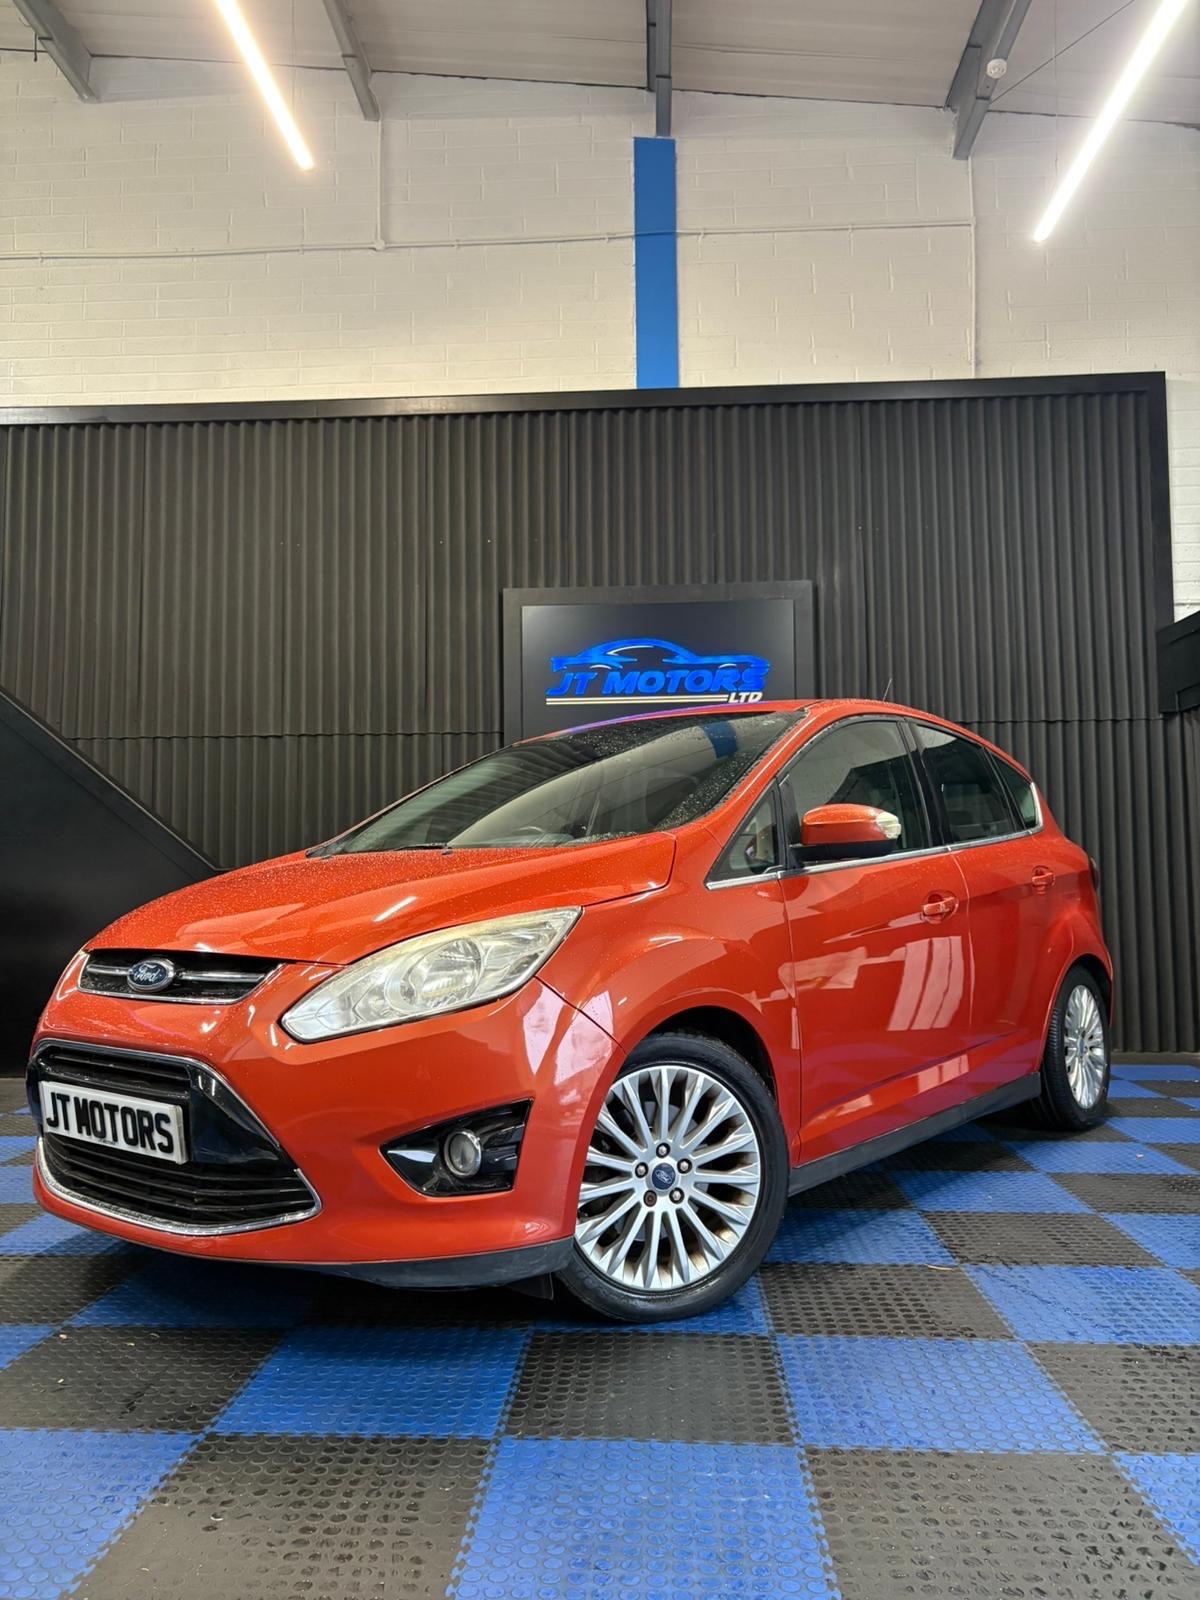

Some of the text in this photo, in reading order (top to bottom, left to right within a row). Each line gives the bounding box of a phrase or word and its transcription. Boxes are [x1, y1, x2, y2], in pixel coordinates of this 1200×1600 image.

[546, 667, 767, 695] JT MOTORS
[728, 692, 763, 704] LTD
[133, 963, 162, 982] Ford
[46, 1092, 174, 1153] JT MOTORS
